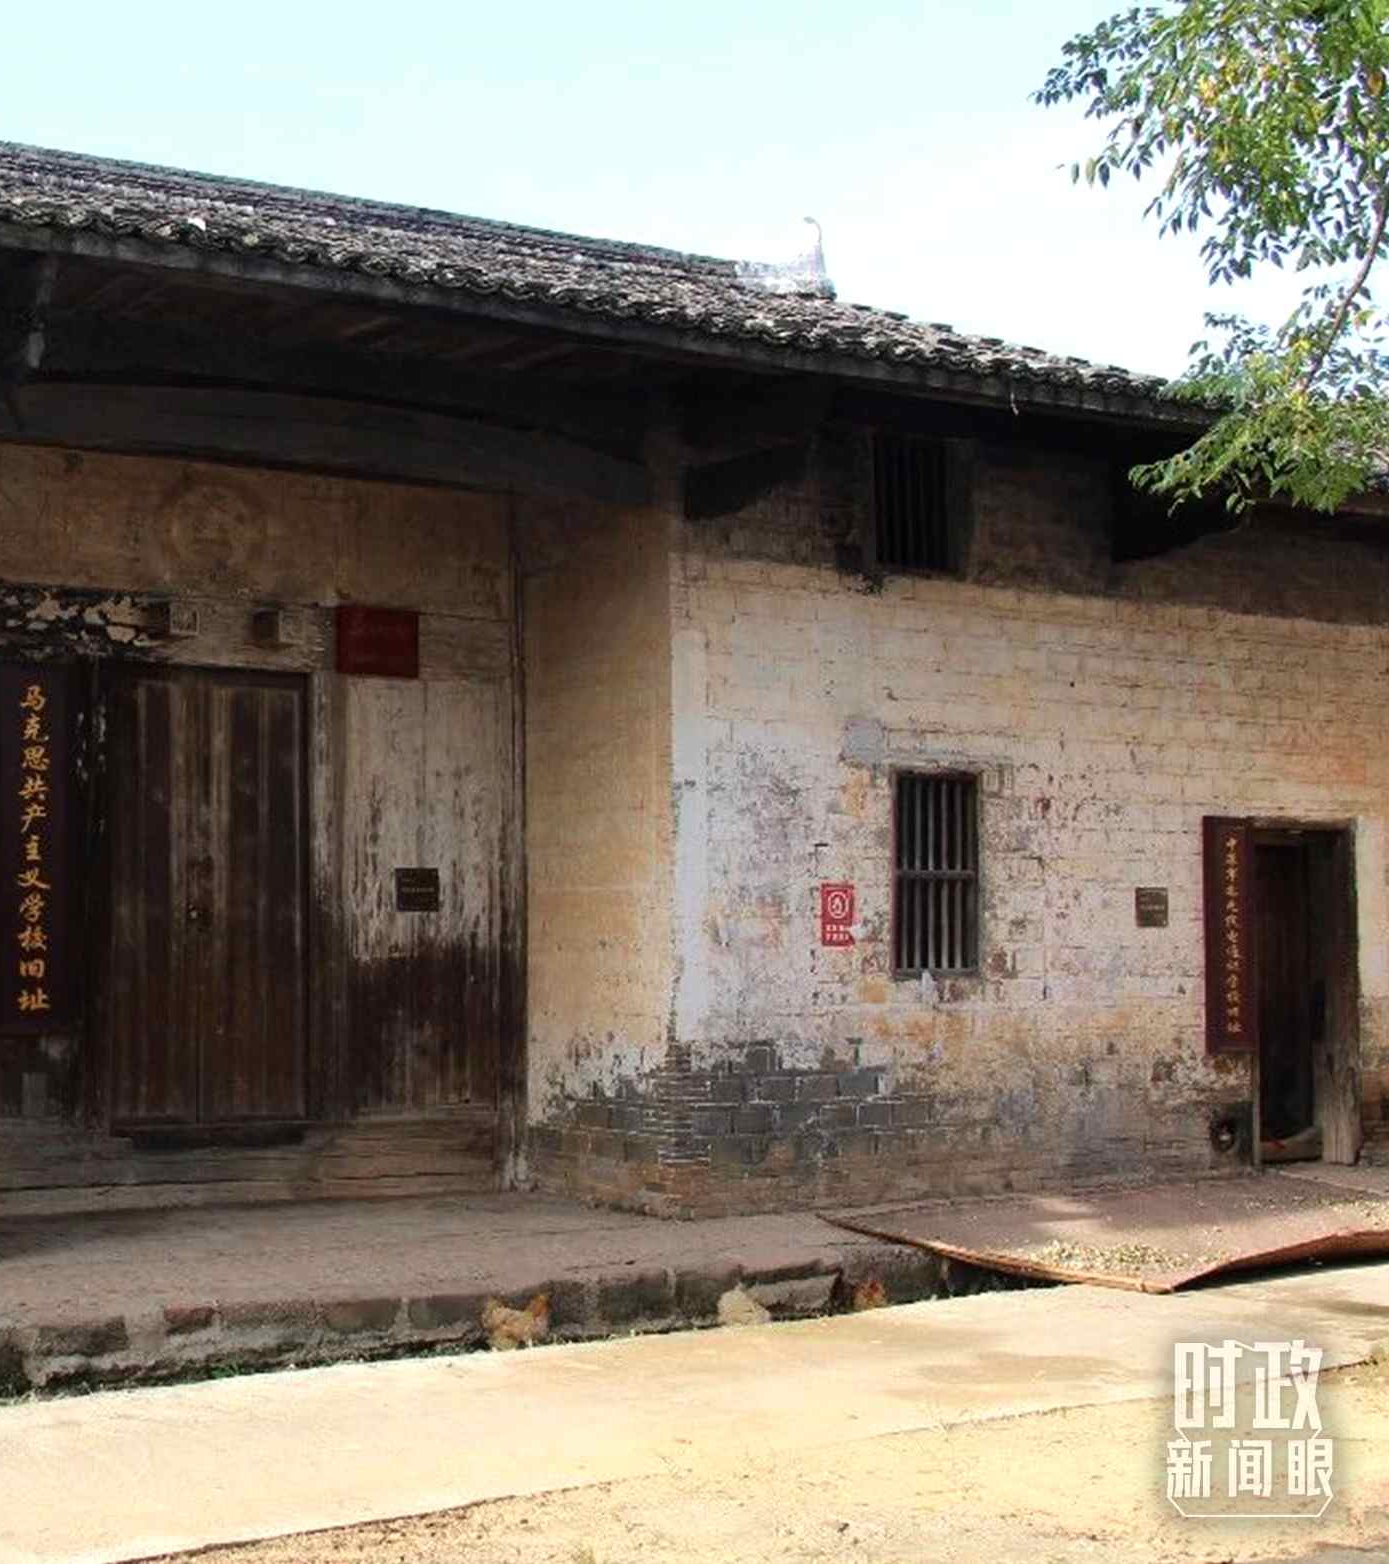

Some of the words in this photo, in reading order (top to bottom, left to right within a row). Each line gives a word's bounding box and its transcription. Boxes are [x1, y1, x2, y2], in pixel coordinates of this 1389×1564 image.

[17, 685, 52, 1011] 马克思共产主义学校旧址
